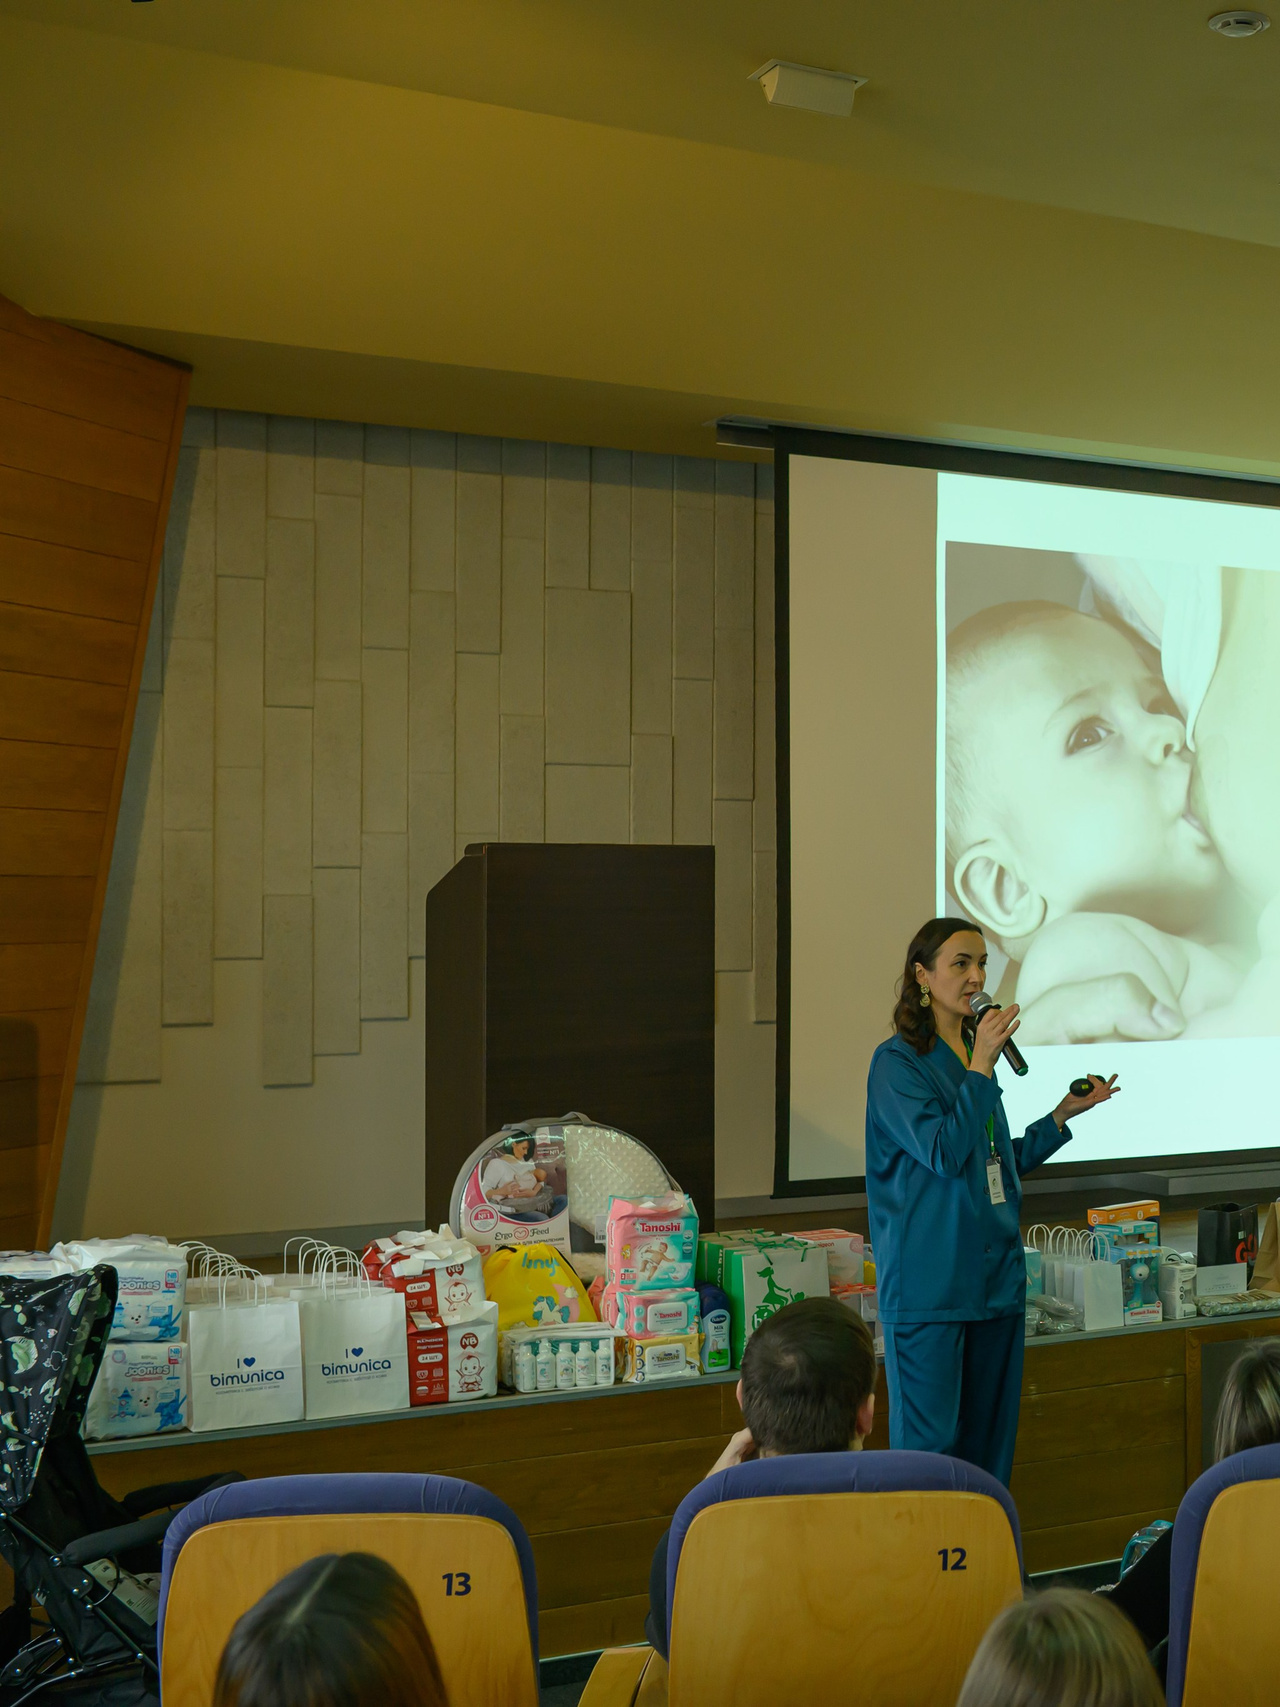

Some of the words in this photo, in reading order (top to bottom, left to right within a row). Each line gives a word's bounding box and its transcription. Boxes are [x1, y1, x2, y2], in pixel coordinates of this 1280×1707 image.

[494, 1232, 513, 1241] Ergo
[529, 1226, 550, 1237] Feed
[462, 1337, 477, 1346] NB
[321, 1358, 392, 1377] bimunica
[210, 1369, 285, 1388] bimunica
[938, 1547, 967, 1571] 12
[442, 1572, 471, 1596] 13
